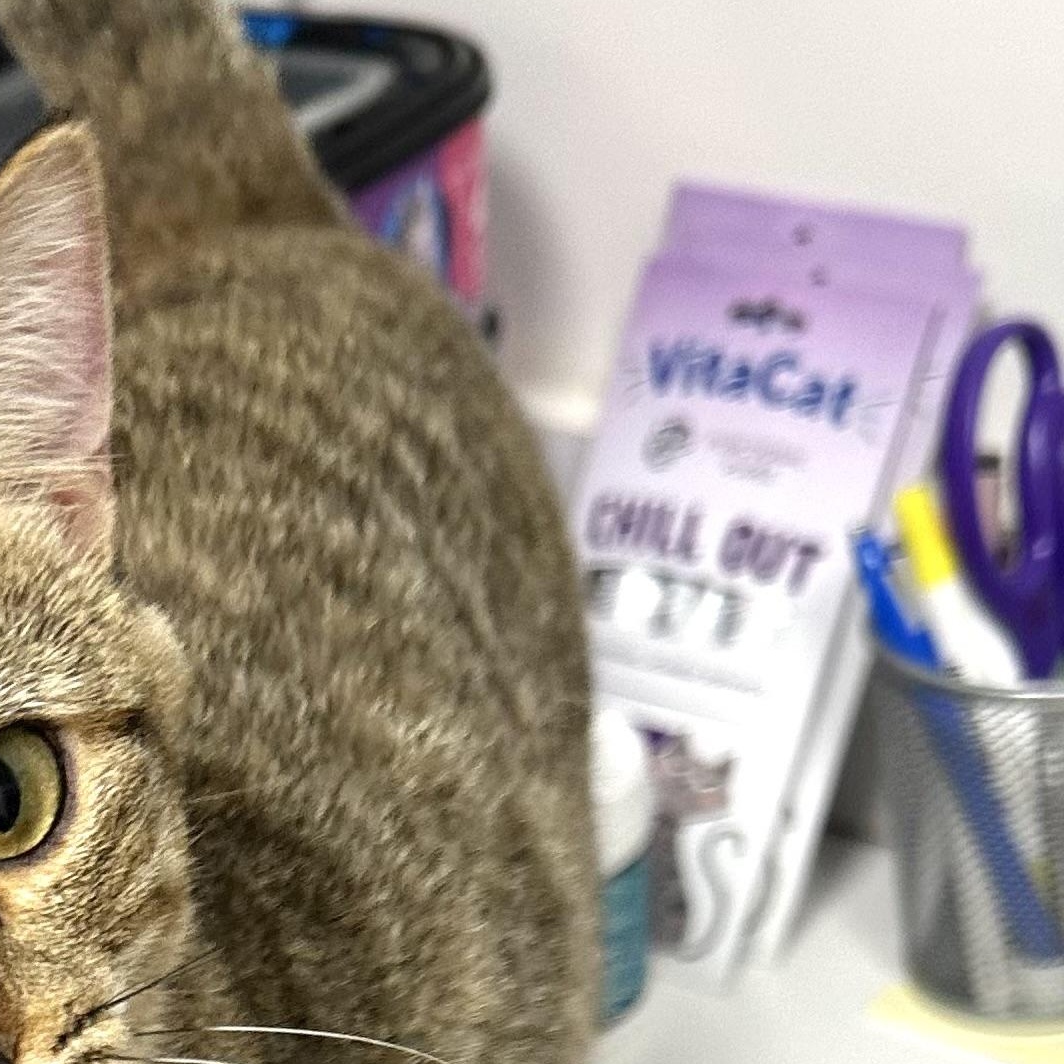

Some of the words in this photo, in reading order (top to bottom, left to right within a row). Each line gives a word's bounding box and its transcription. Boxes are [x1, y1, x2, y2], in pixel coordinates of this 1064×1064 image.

[648, 336, 856, 426] VitaCat
[587, 498, 705, 562] CHILL
[718, 517, 825, 597] OUT
